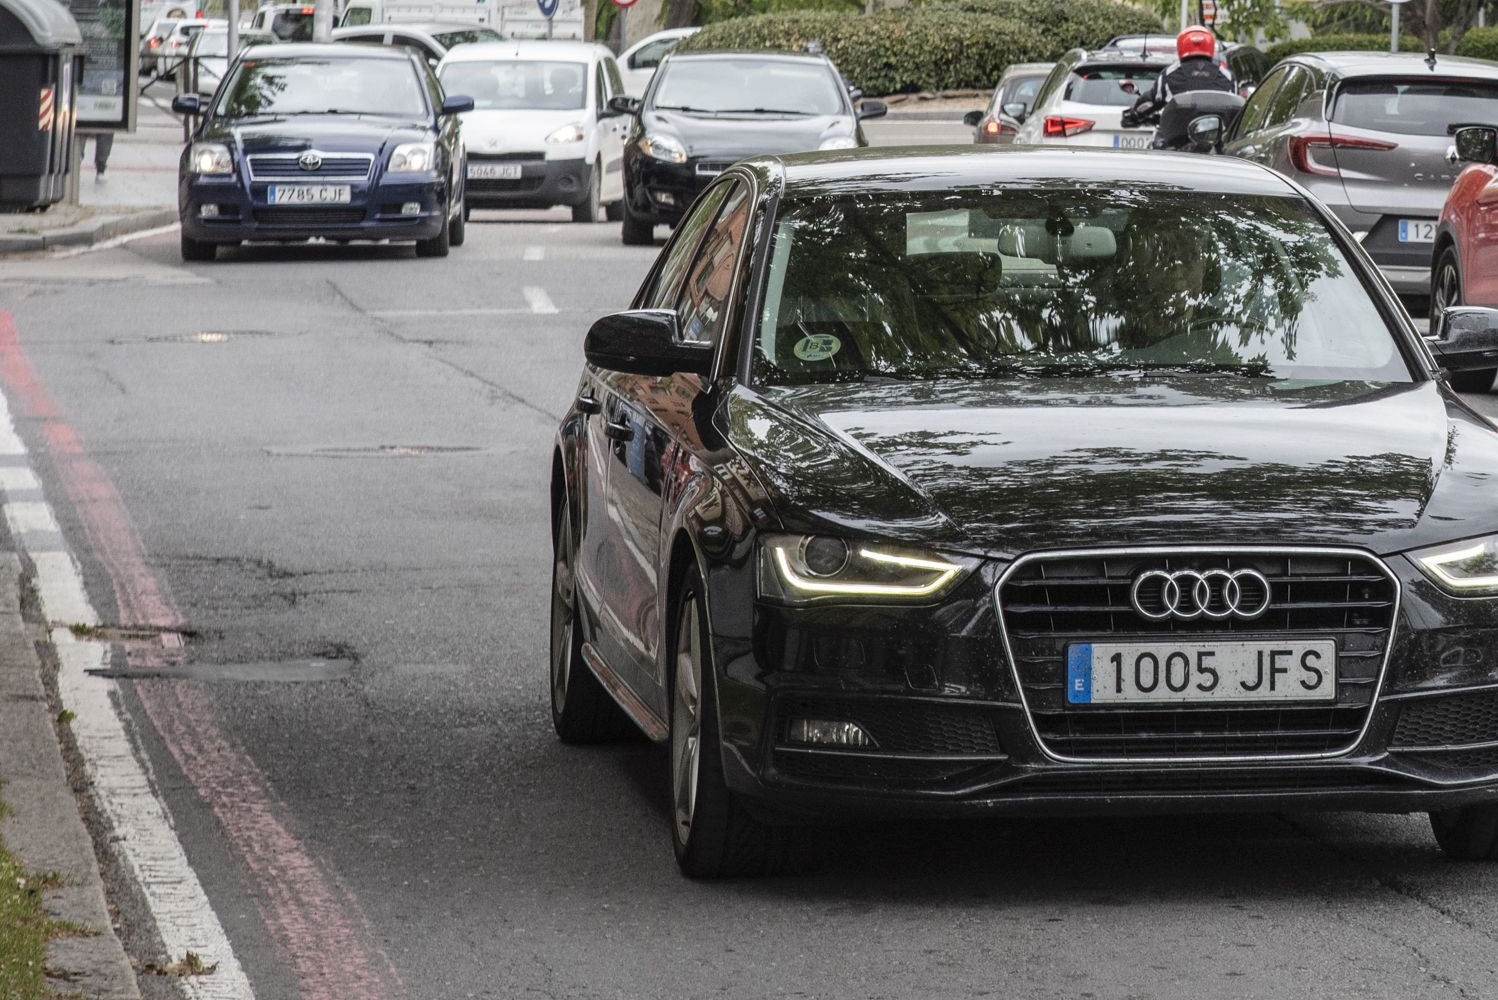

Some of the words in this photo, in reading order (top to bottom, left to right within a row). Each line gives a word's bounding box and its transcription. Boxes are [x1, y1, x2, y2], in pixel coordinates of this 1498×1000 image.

[278, 187, 314, 201] 7785
[320, 187, 345, 201] CJF
[1074, 679, 1085, 692] E
[1110, 650, 1219, 694] 1005
[1239, 649, 1323, 692] JFS
